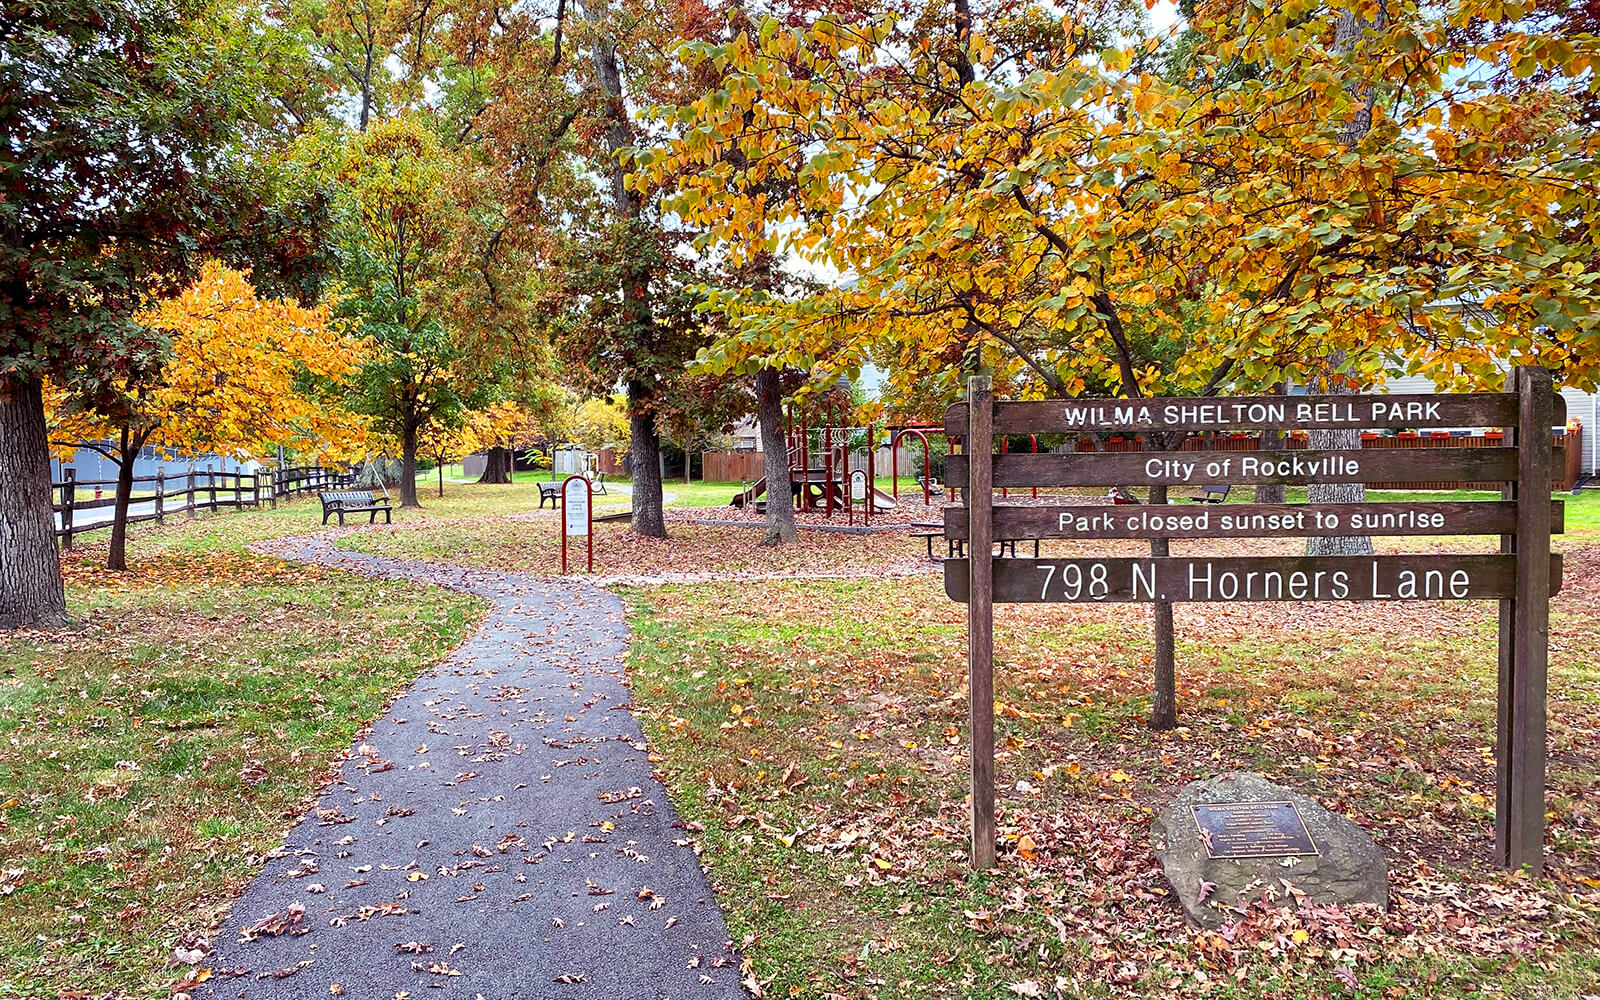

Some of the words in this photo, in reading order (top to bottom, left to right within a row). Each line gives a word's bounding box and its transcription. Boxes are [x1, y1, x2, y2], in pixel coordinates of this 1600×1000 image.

[1064, 406, 1153, 426] WILMA
[1163, 403, 1285, 425] SHELTON
[1296, 403, 1361, 423] BELL
[1371, 401, 1441, 421] PARK
[1145, 458, 1195, 482] City
[1205, 458, 1231, 477] of
[1241, 455, 1360, 477] Rockville
[1058, 512, 1115, 531] Park
[1126, 511, 1209, 531] closed
[1220, 511, 1305, 530] sunset
[1314, 511, 1339, 530] to
[1350, 510, 1445, 529] sunrise
[1036, 563, 1109, 600] 798
[1131, 562, 1166, 600] N.
[1188, 562, 1349, 600] Horners
[1372, 560, 1470, 599] Lane
